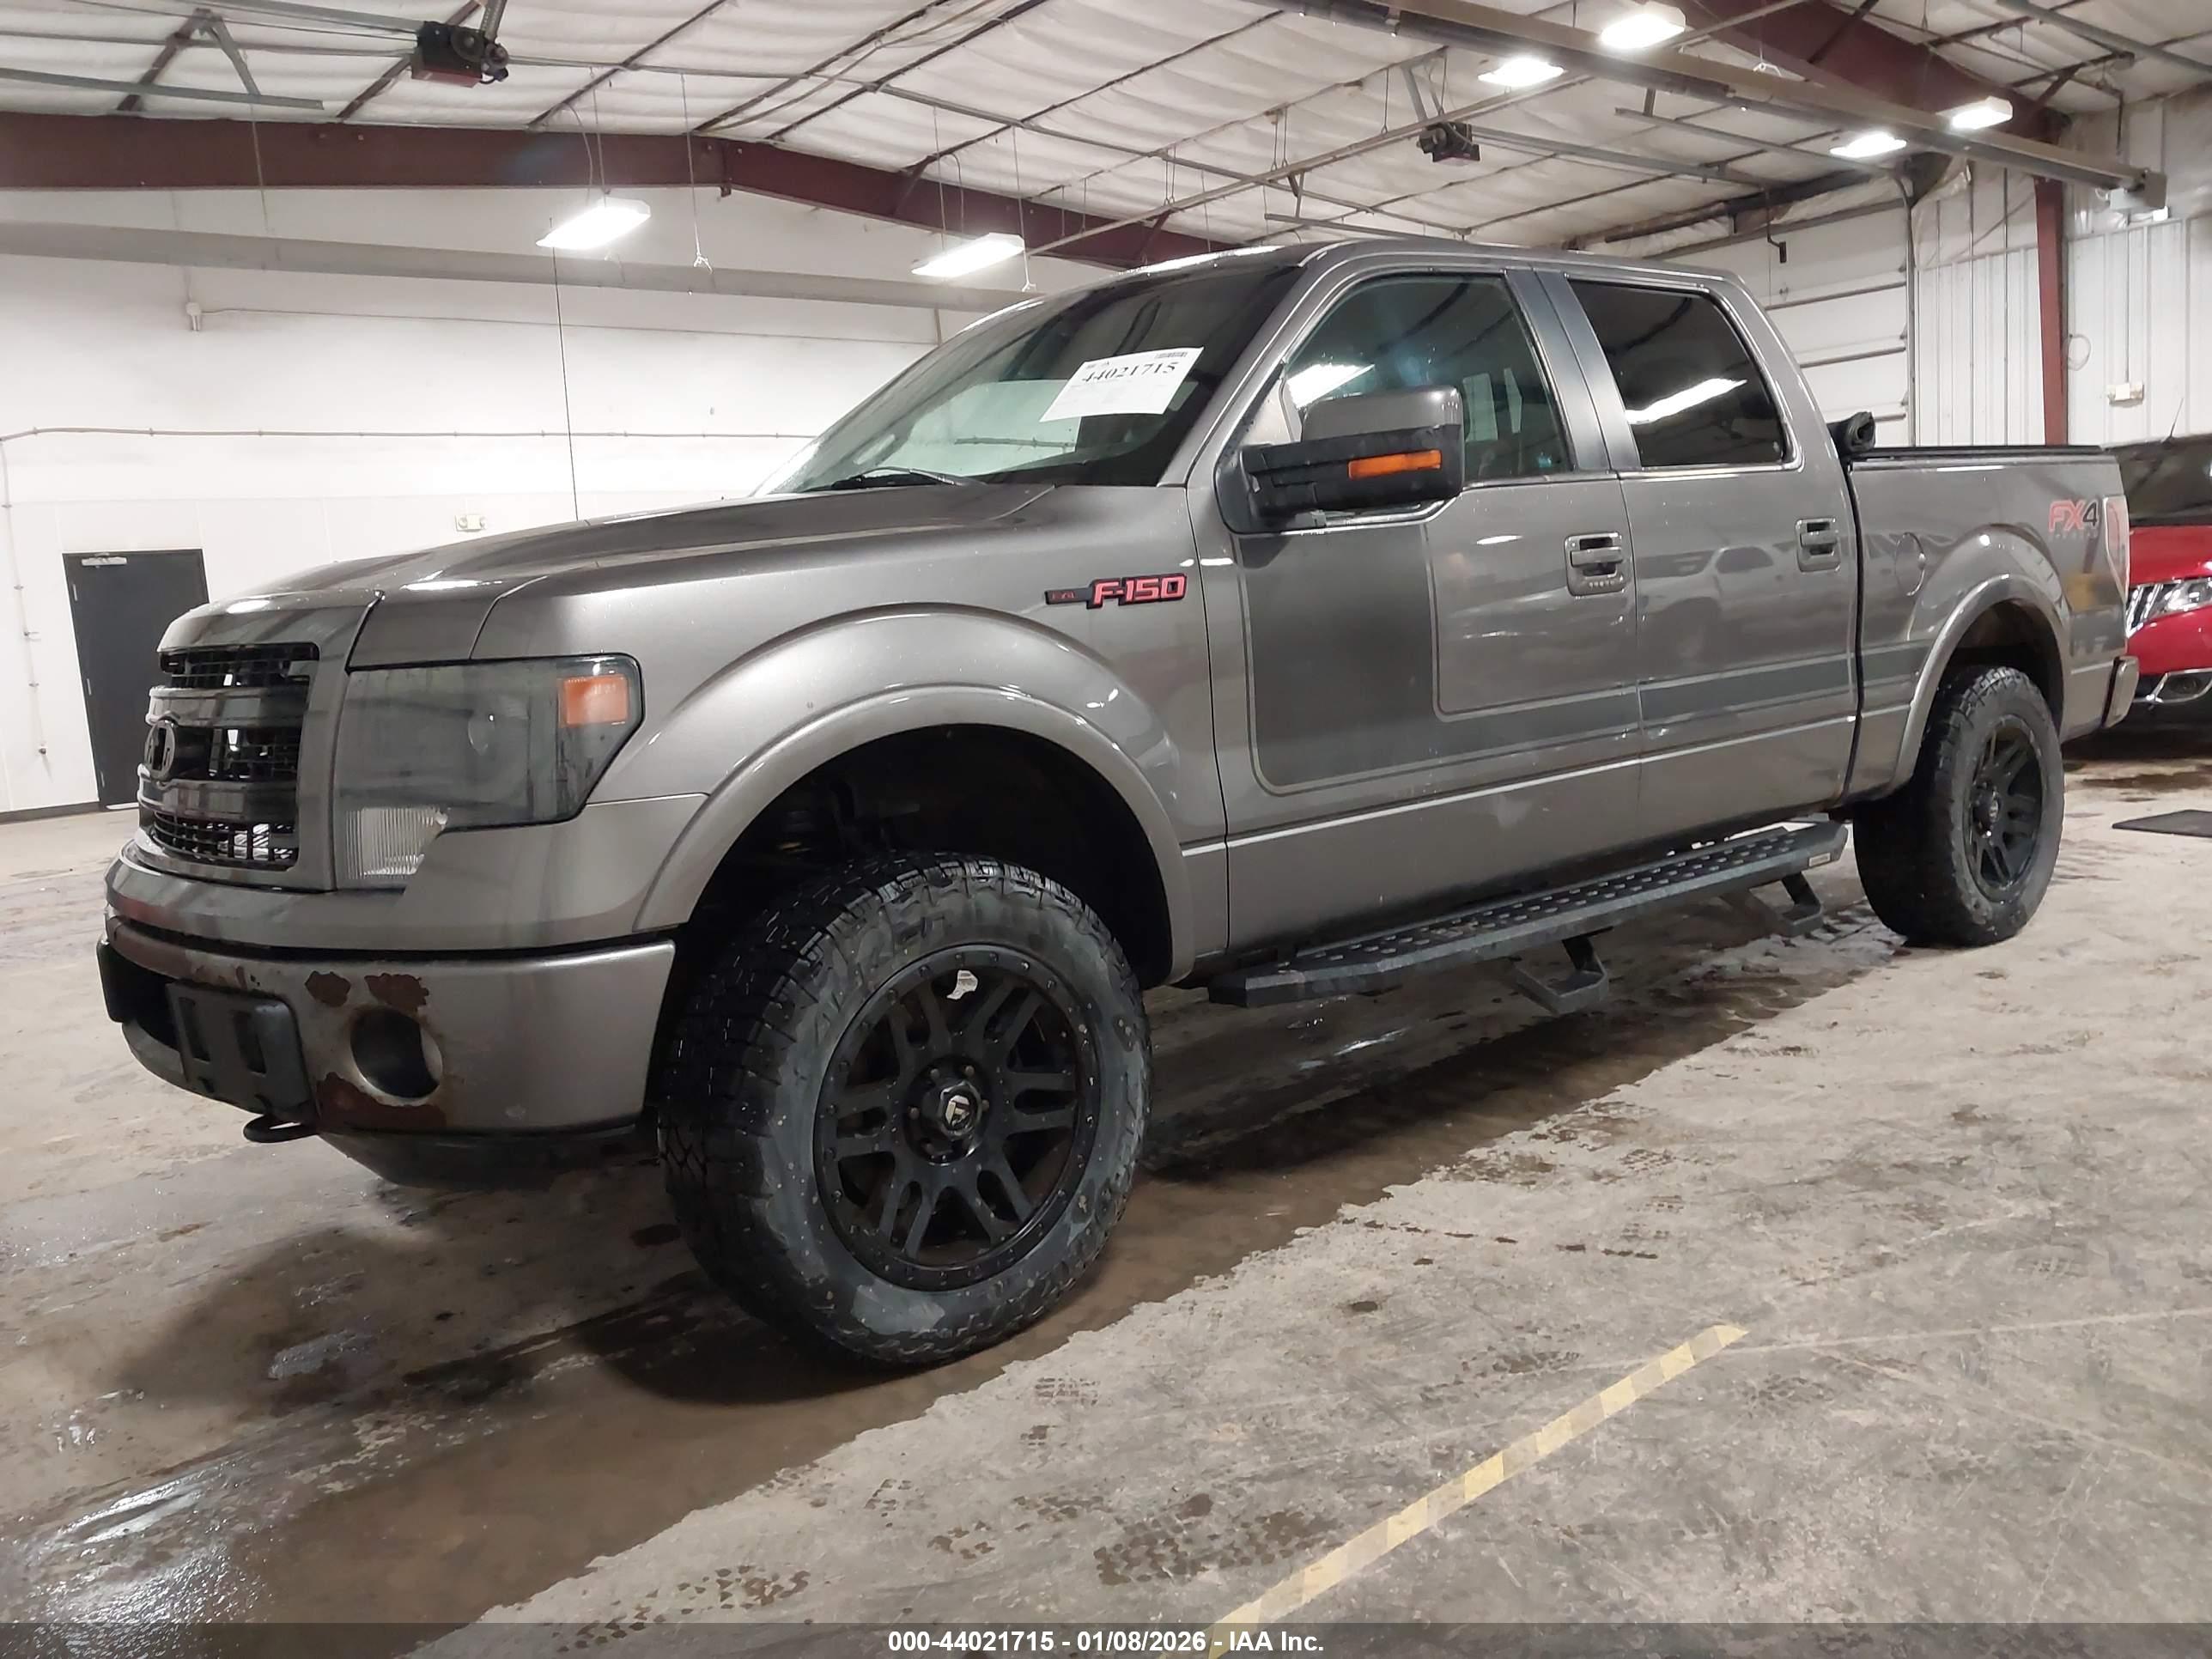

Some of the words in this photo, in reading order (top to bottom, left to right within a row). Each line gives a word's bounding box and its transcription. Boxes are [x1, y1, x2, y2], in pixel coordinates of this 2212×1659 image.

[1082, 362, 1179, 382] 44021715
[2047, 498, 2100, 532] FX4
[1092, 574, 1187, 606] F-150
